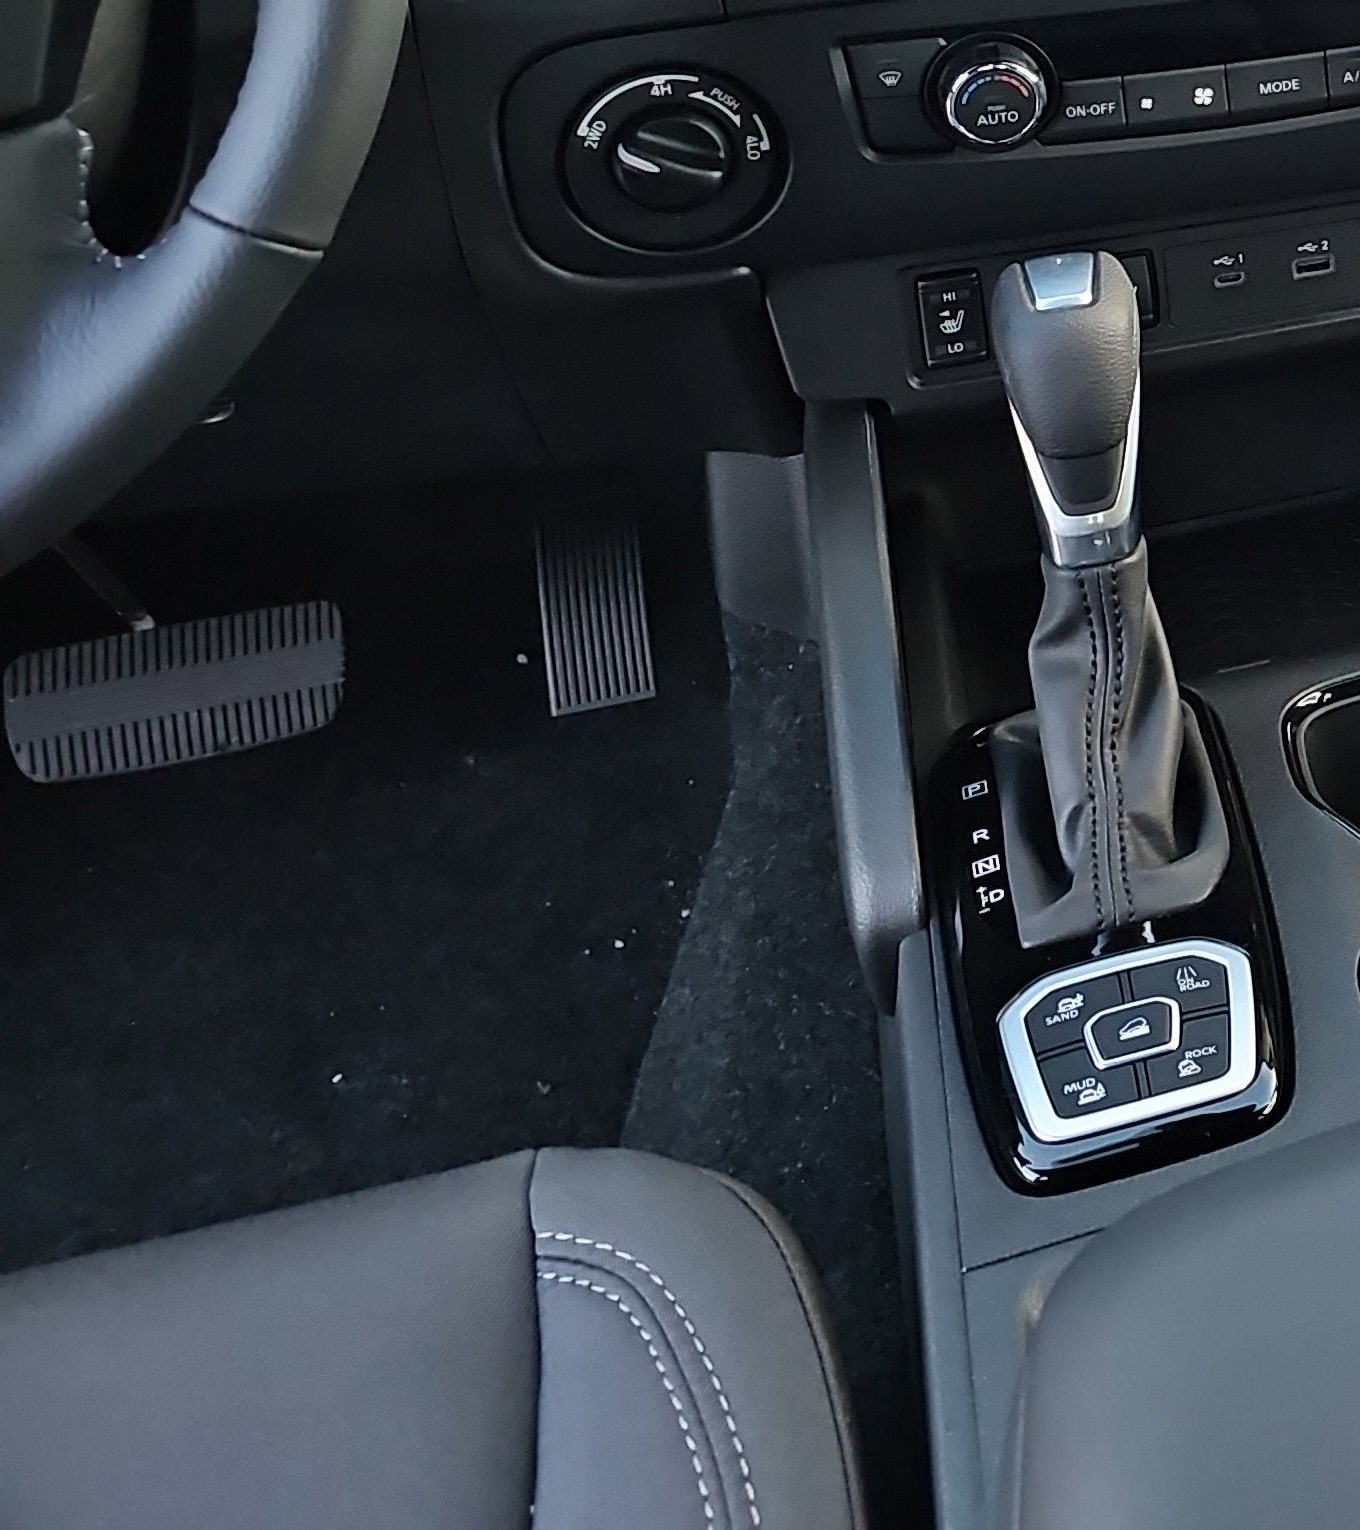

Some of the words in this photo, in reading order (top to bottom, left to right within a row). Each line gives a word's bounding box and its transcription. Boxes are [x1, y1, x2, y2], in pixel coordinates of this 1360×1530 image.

[650, 84, 673, 98] 4H
[1258, 78, 1301, 95] MODE
[709, 87, 741, 111] PUSH
[976, 110, 1019, 127] AUTO
[583, 119, 608, 151] 2WD
[1320, 239, 1329, 252] 2
[1238, 253, 1244, 264] 1
[942, 291, 957, 302] HI
[947, 342, 964, 354] LO
[972, 828, 989, 844] R
[988, 888, 1005, 902] D
[1179, 978, 1211, 993] ROAD
[1045, 1008, 1079, 1026] SAND
[1185, 1044, 1218, 1059] ROCK
[1063, 1077, 1097, 1094] MUD
